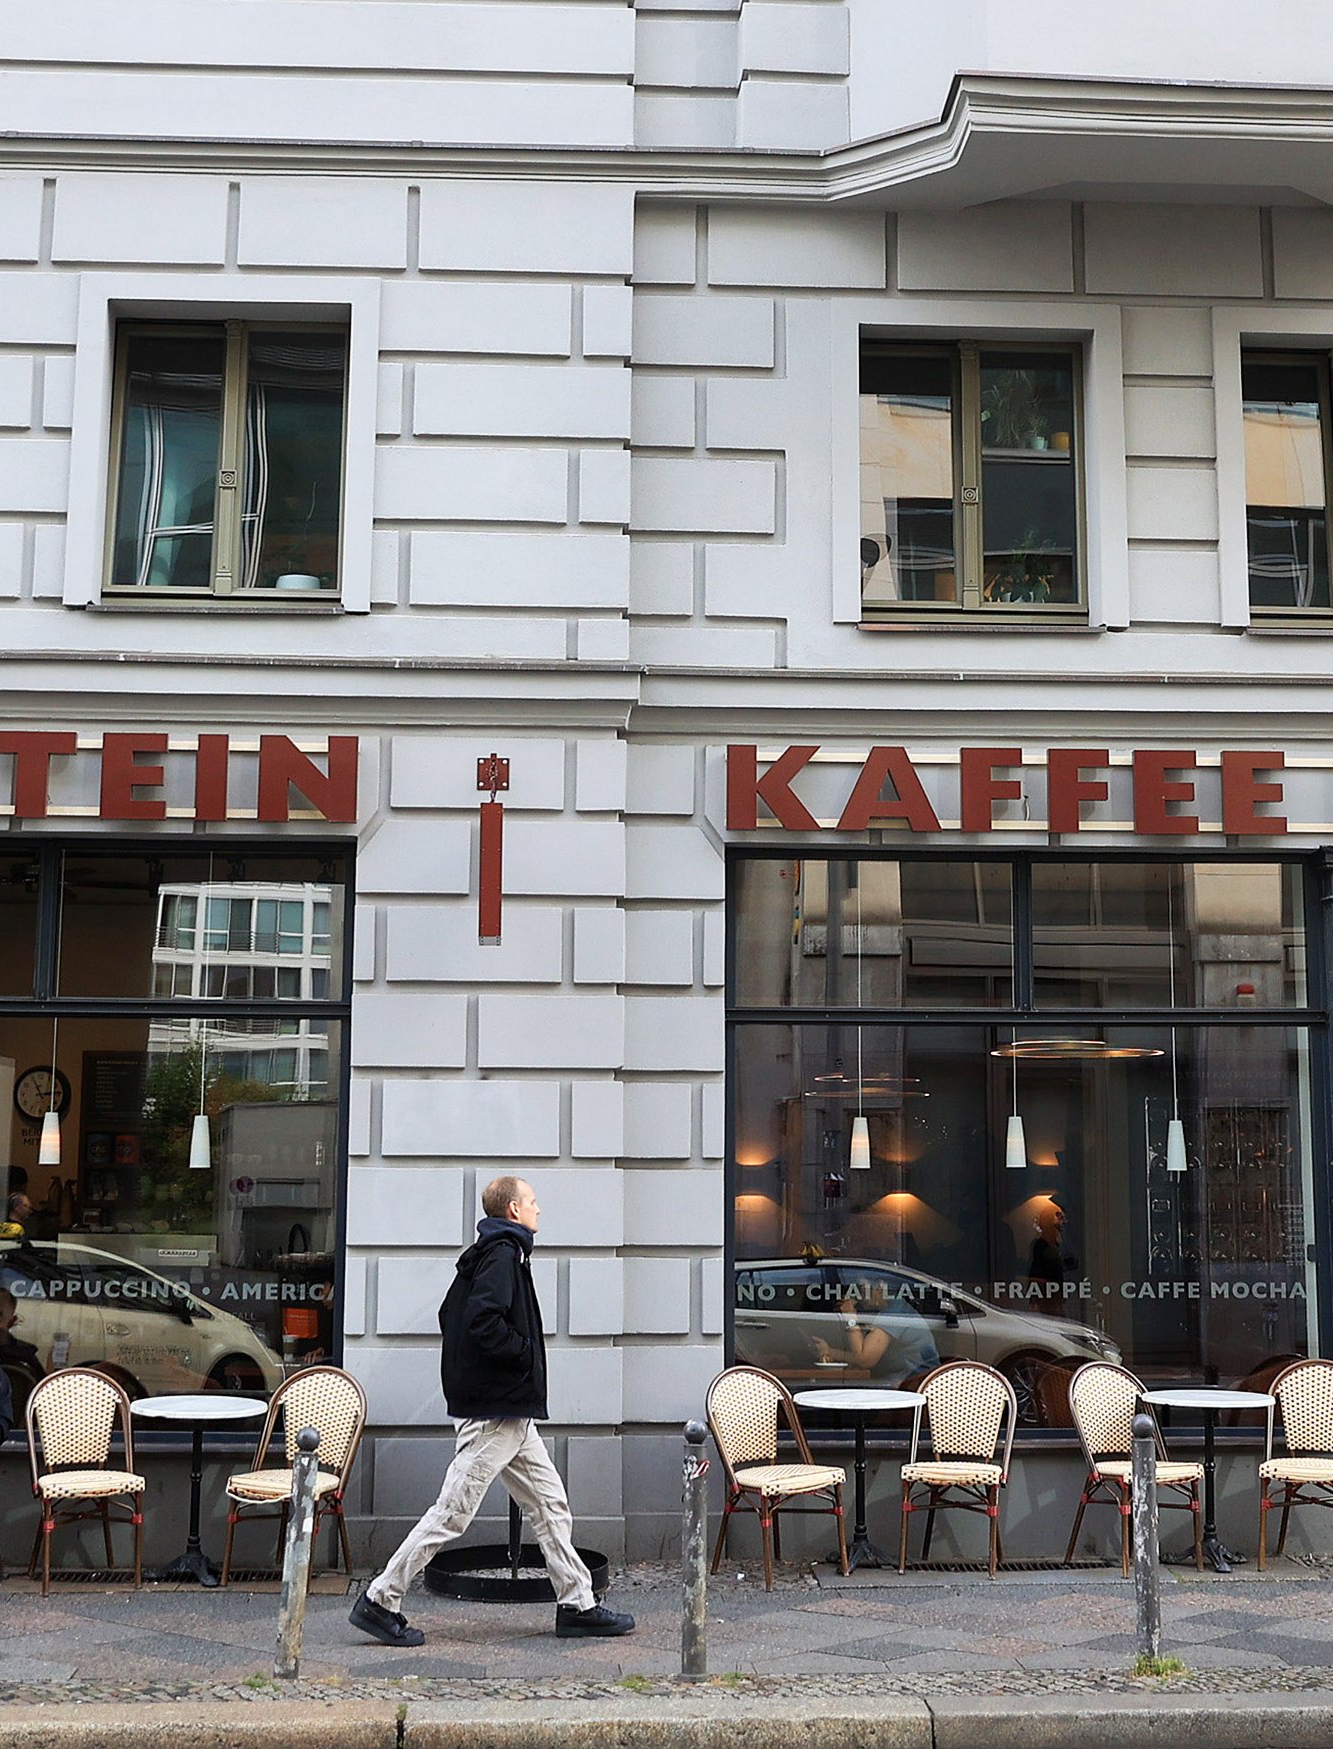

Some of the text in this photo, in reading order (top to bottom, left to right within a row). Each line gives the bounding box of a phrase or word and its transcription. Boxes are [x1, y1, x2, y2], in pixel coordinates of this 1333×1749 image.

[726, 744, 1288, 835] KAFFEE
[10, 1279, 191, 1299] CAPPUCCINO
[736, 1276, 1307, 1301] NO CHAI LATTE FRAPPÉ CAFFE MOCHA
